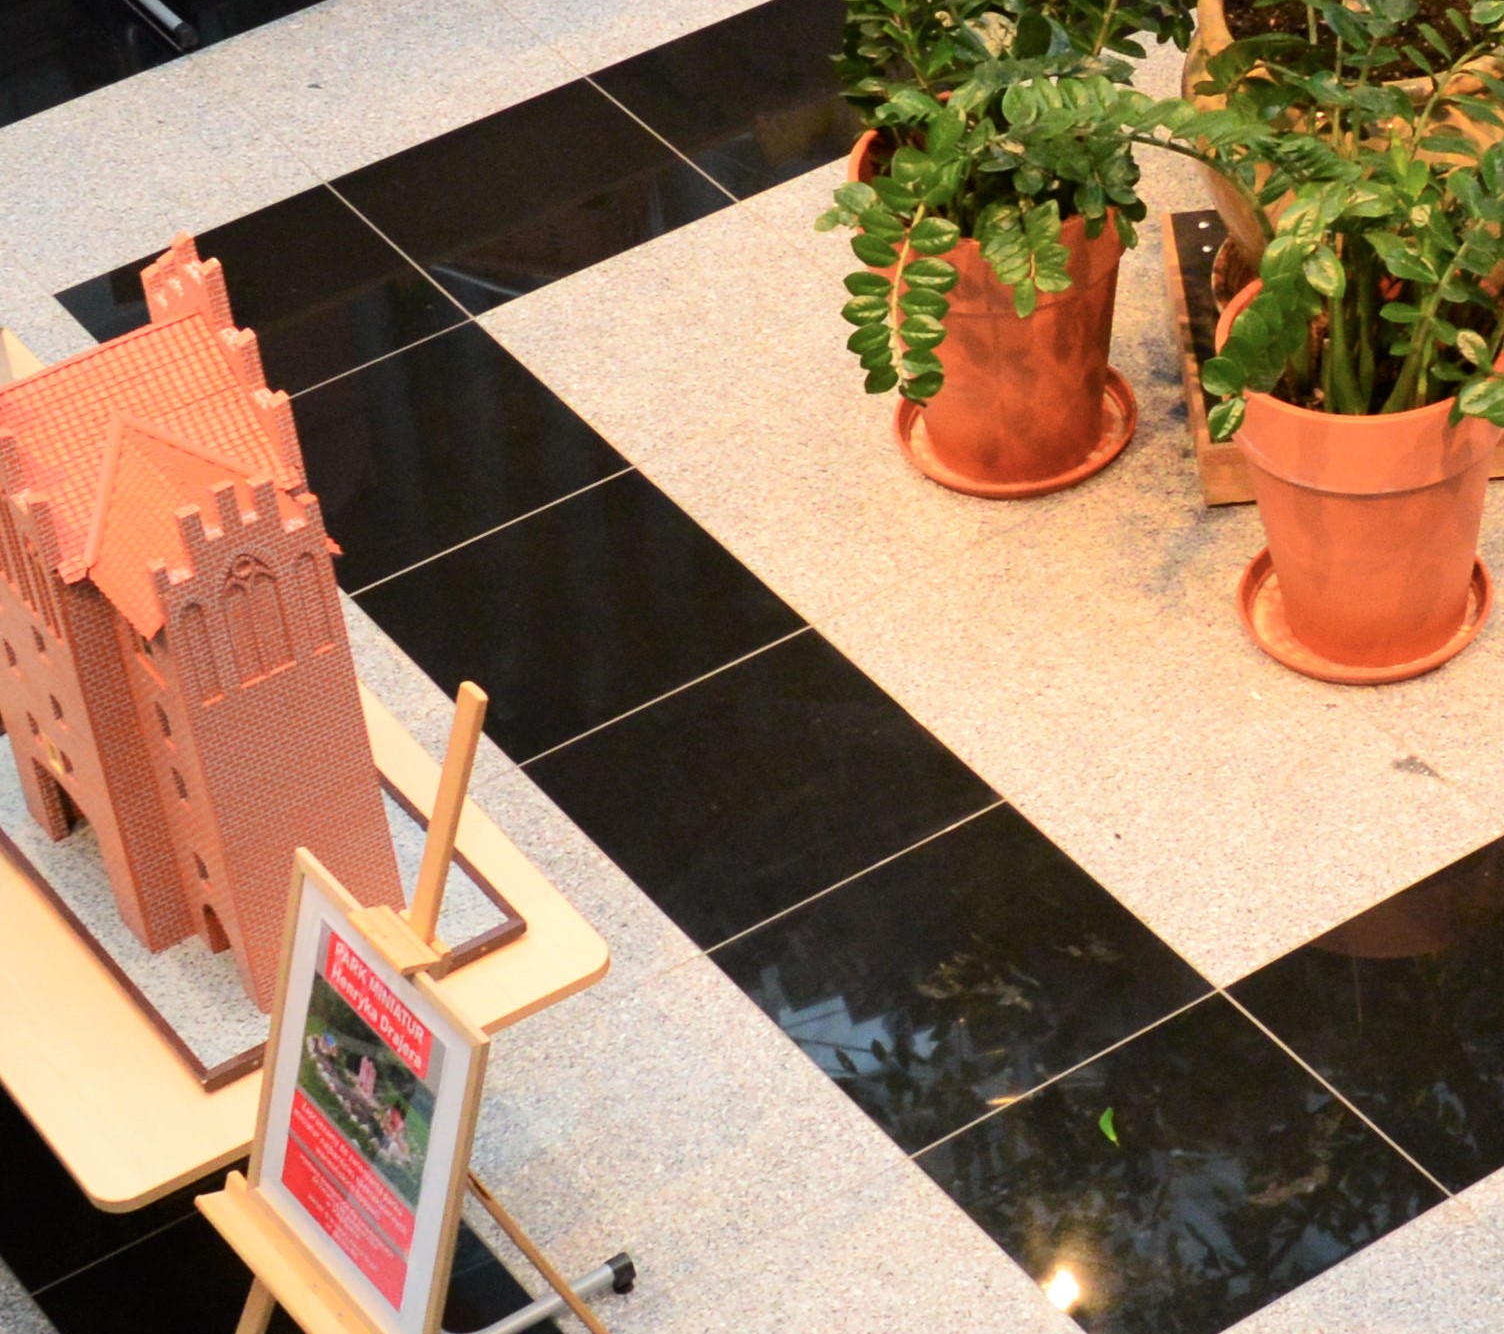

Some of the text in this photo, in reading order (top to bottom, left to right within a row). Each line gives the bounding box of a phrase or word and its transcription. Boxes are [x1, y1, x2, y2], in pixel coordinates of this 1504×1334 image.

[330, 963, 423, 1072] Henryka Drajera
[334, 939, 424, 1046] PARK MINIATUR
